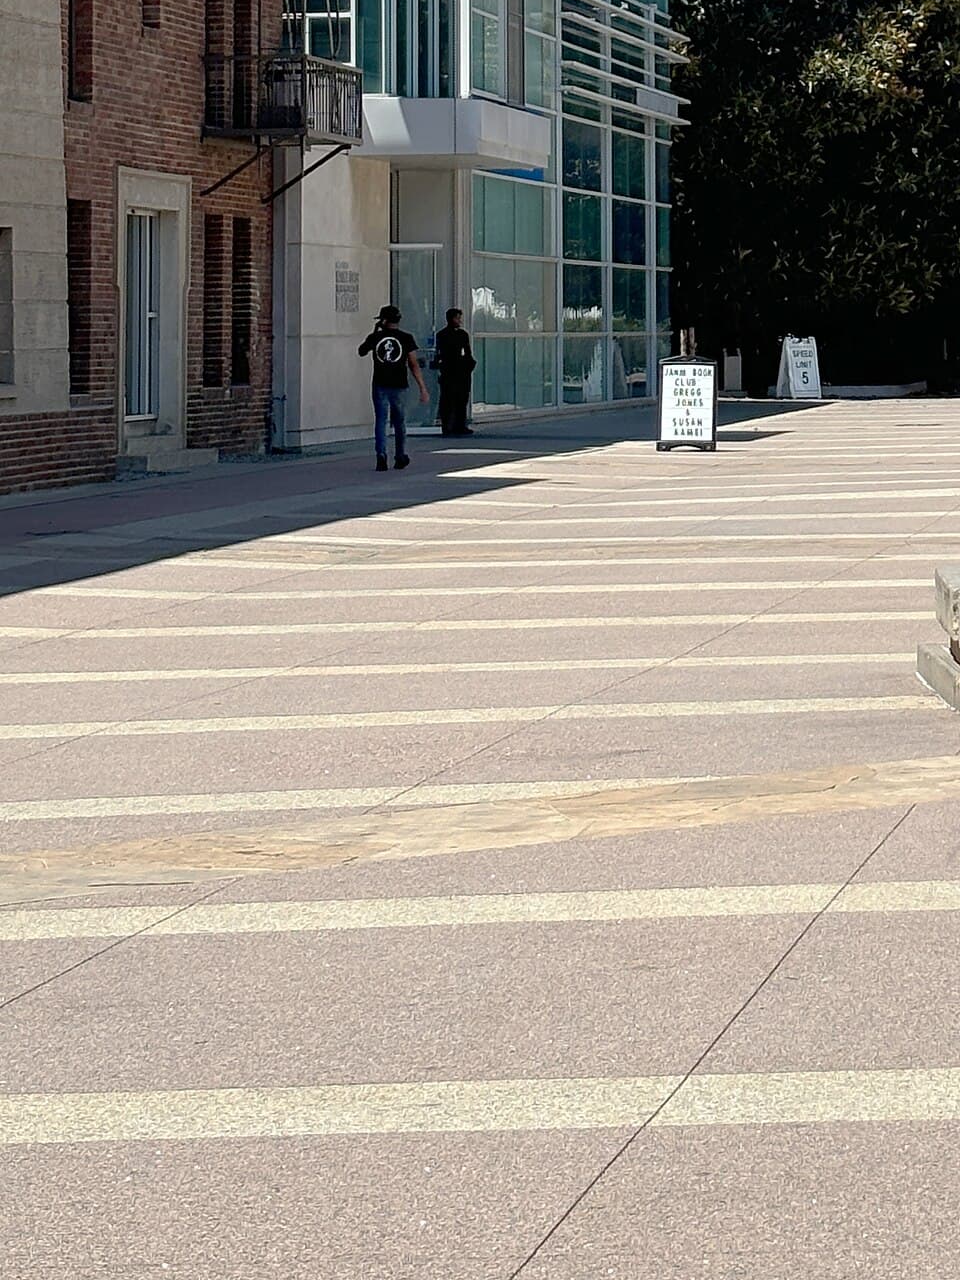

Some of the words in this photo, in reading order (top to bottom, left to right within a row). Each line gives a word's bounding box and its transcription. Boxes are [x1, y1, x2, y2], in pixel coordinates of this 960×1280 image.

[692, 368, 713, 376] BOOK
[802, 371, 809, 384] 5
[675, 378, 696, 386] CLUB
[673, 388, 701, 396] GREGG
[675, 398, 703, 407] JONES
[672, 418, 703, 426] SUSAN
